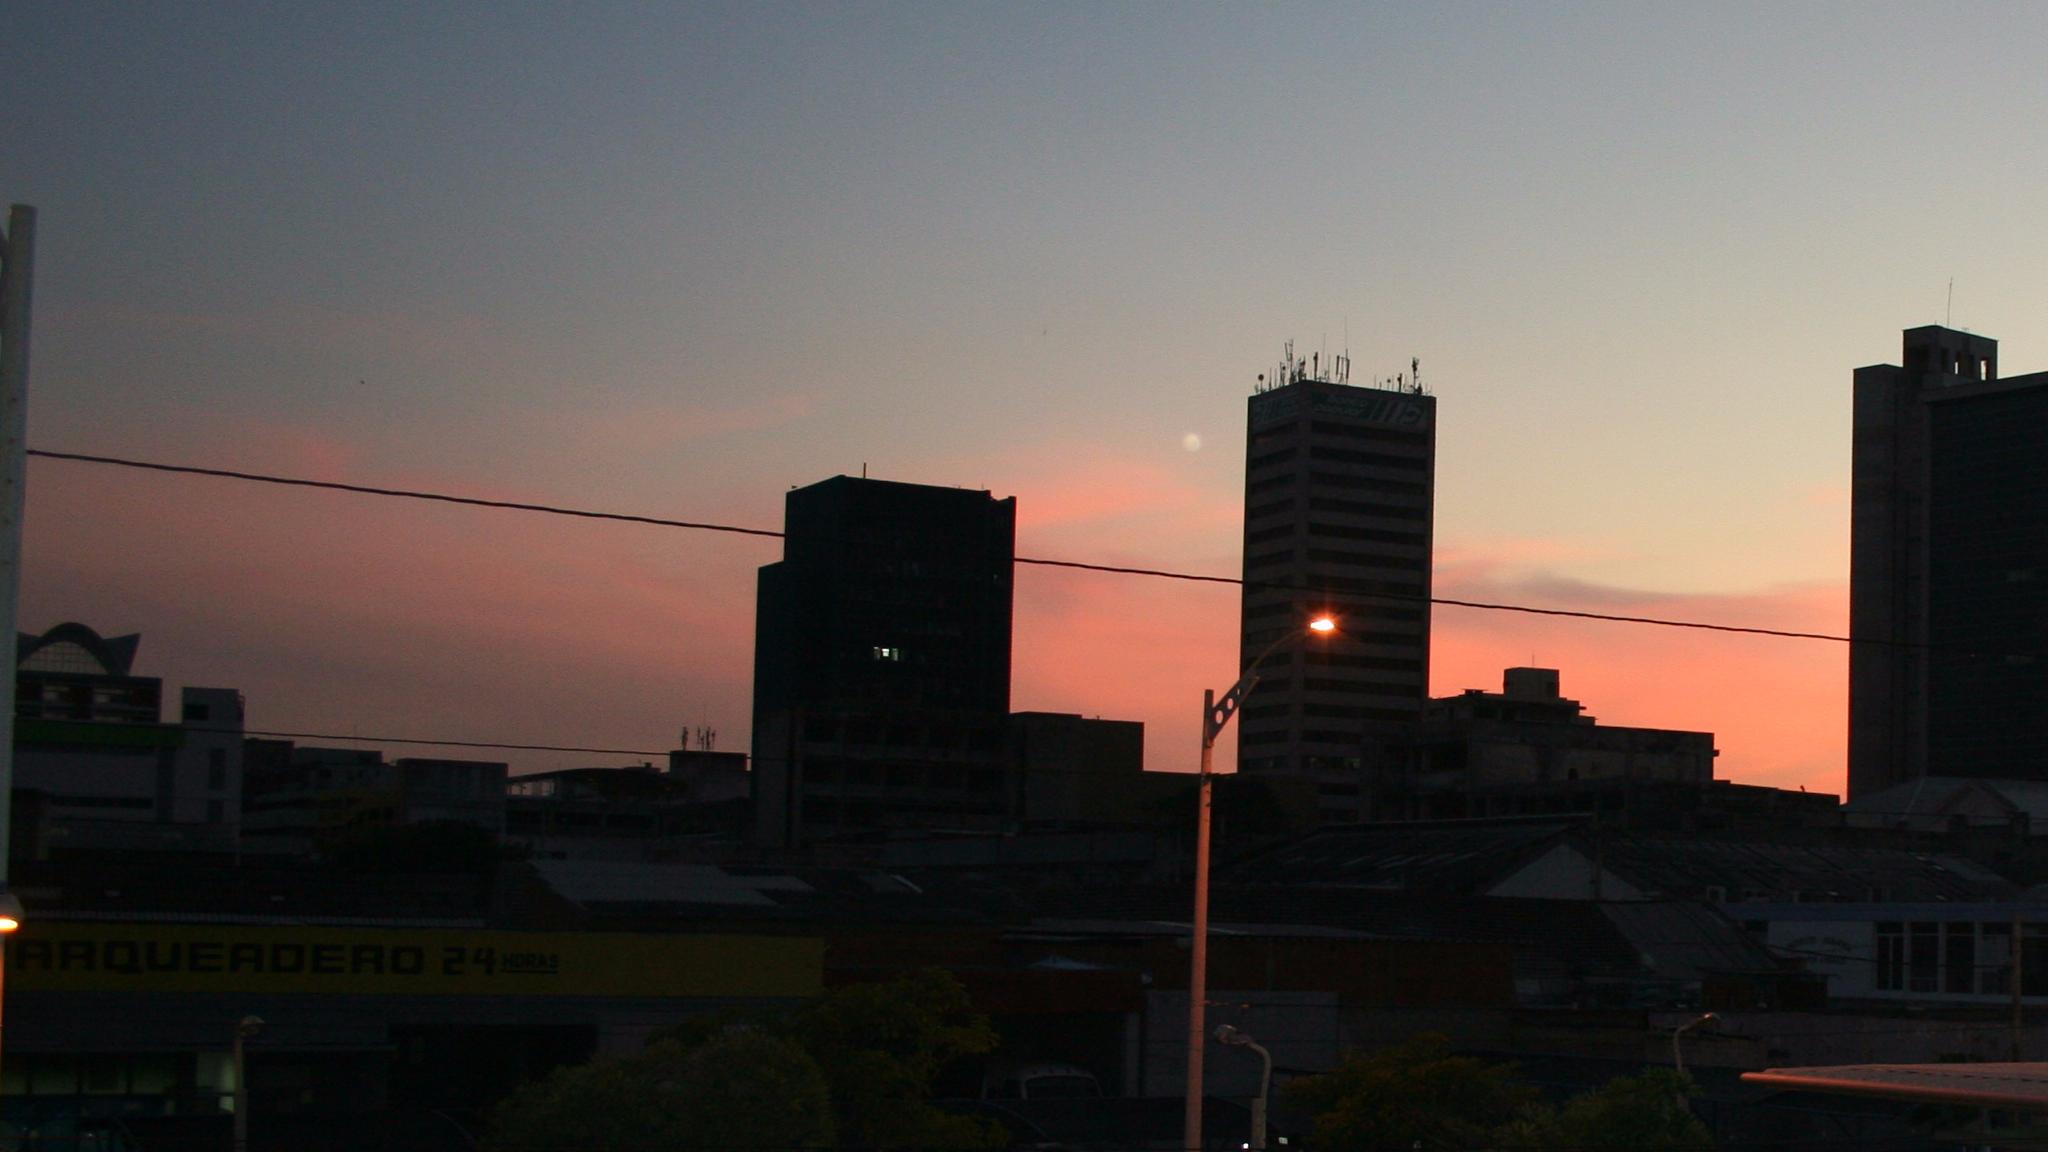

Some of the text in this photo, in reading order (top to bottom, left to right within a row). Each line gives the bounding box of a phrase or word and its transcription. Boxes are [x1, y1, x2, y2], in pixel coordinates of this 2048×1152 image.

[6, 939, 559, 976] ARQUEADERO 24 HORAS
